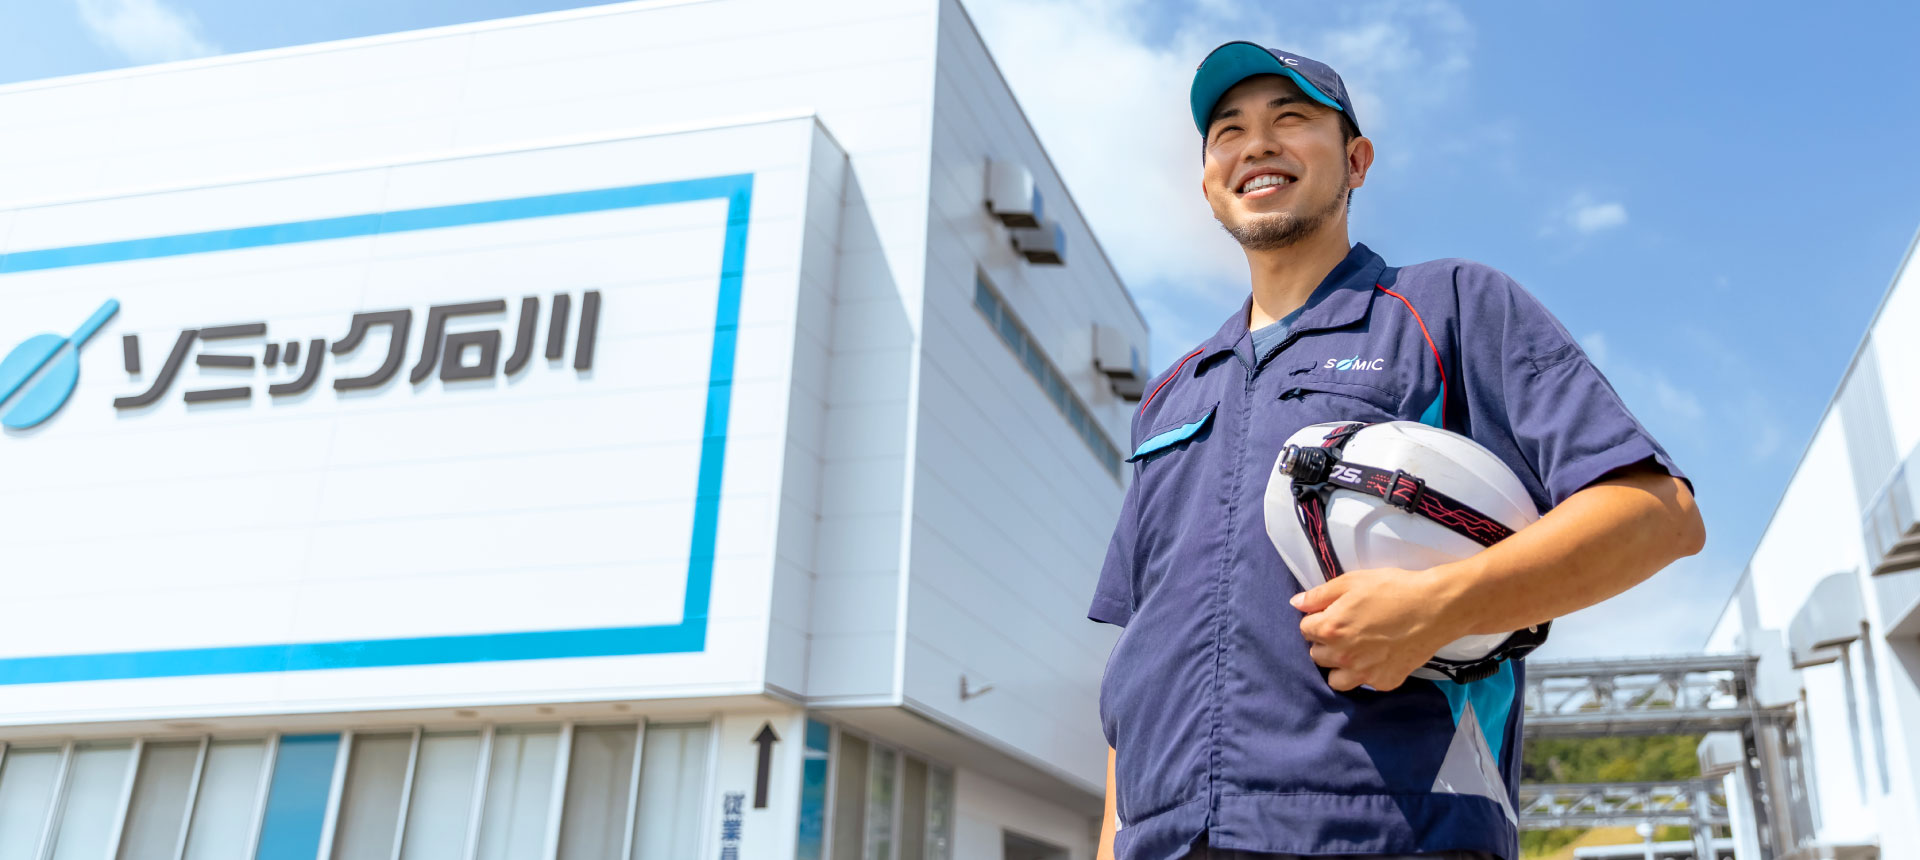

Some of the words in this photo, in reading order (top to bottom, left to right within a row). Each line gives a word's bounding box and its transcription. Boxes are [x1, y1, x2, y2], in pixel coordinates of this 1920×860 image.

[113, 290, 602, 409] ソミック石川
[1323, 355, 1385, 371] SOMIC
